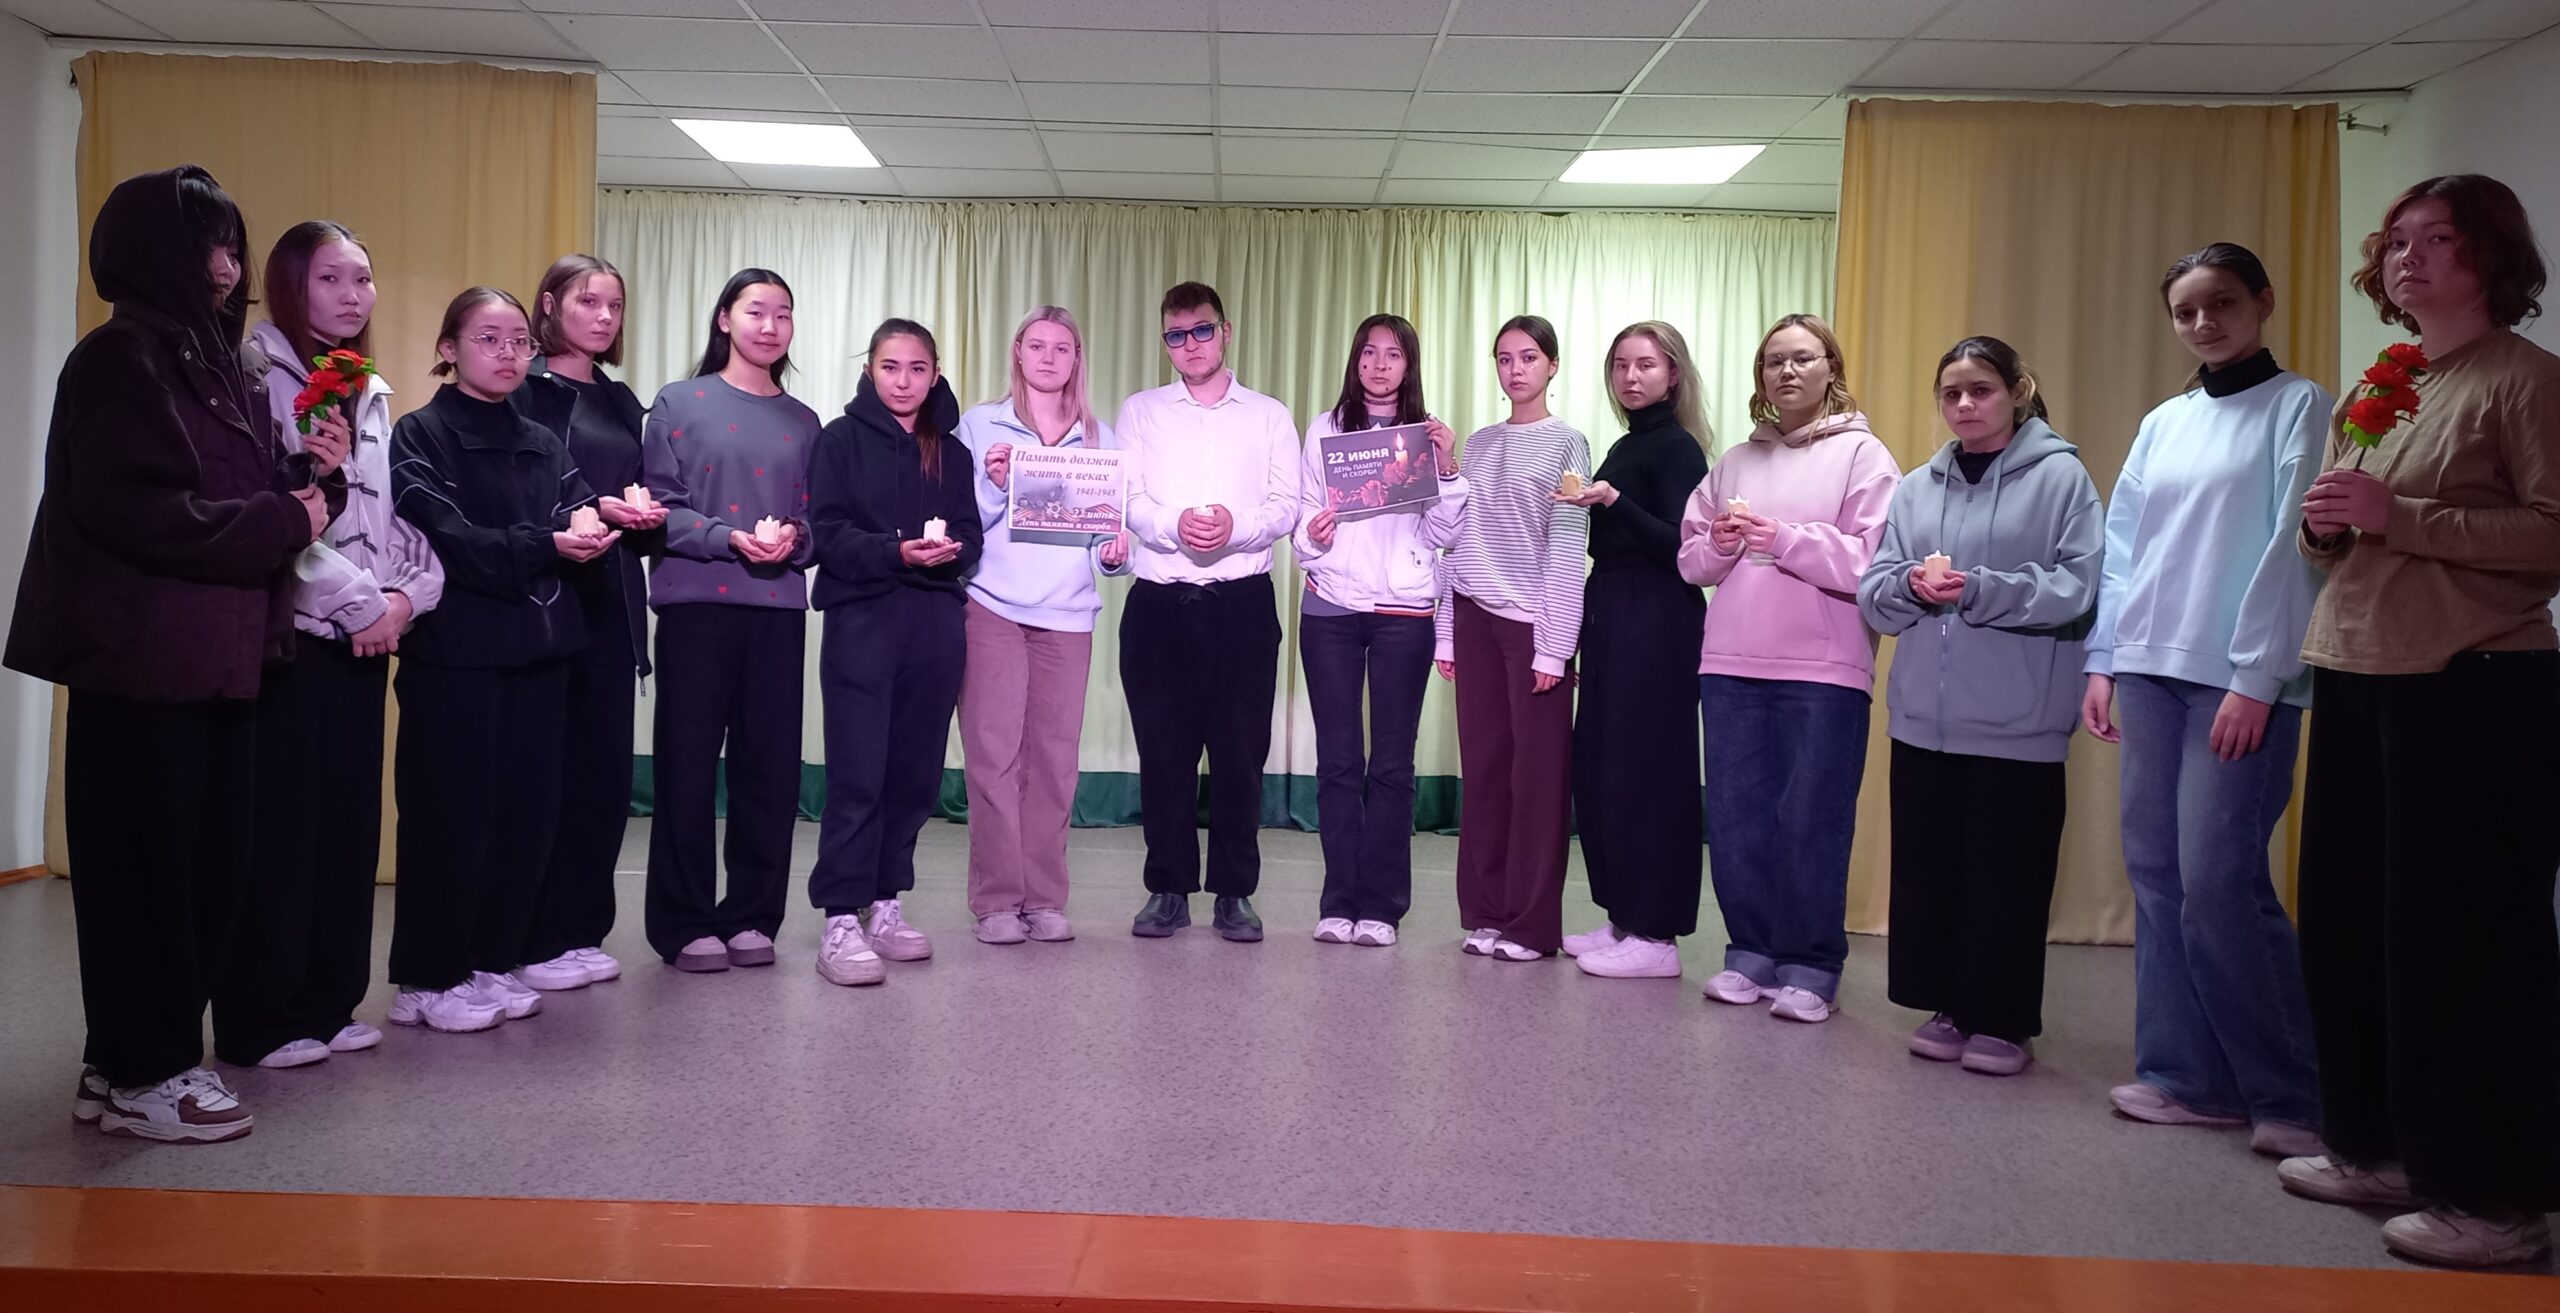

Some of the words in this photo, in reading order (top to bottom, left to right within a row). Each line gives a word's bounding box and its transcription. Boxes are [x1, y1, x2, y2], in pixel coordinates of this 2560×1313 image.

[1015, 451, 1066, 463] Память
[1070, 454, 1118, 466] должна
[1327, 451, 1345, 464] 22
[1333, 465, 1352, 474] ДЕНЬ
[1353, 462, 1382, 470] ПАМЯТИ
[1349, 468, 1378, 478] СКОРБИ
[1024, 469, 1062, 479] жить
[1075, 473, 1110, 481] веках
[1076, 488, 1116, 496] 1941-1945
[1072, 508, 1087, 518] 22
[1018, 518, 1039, 527] День
